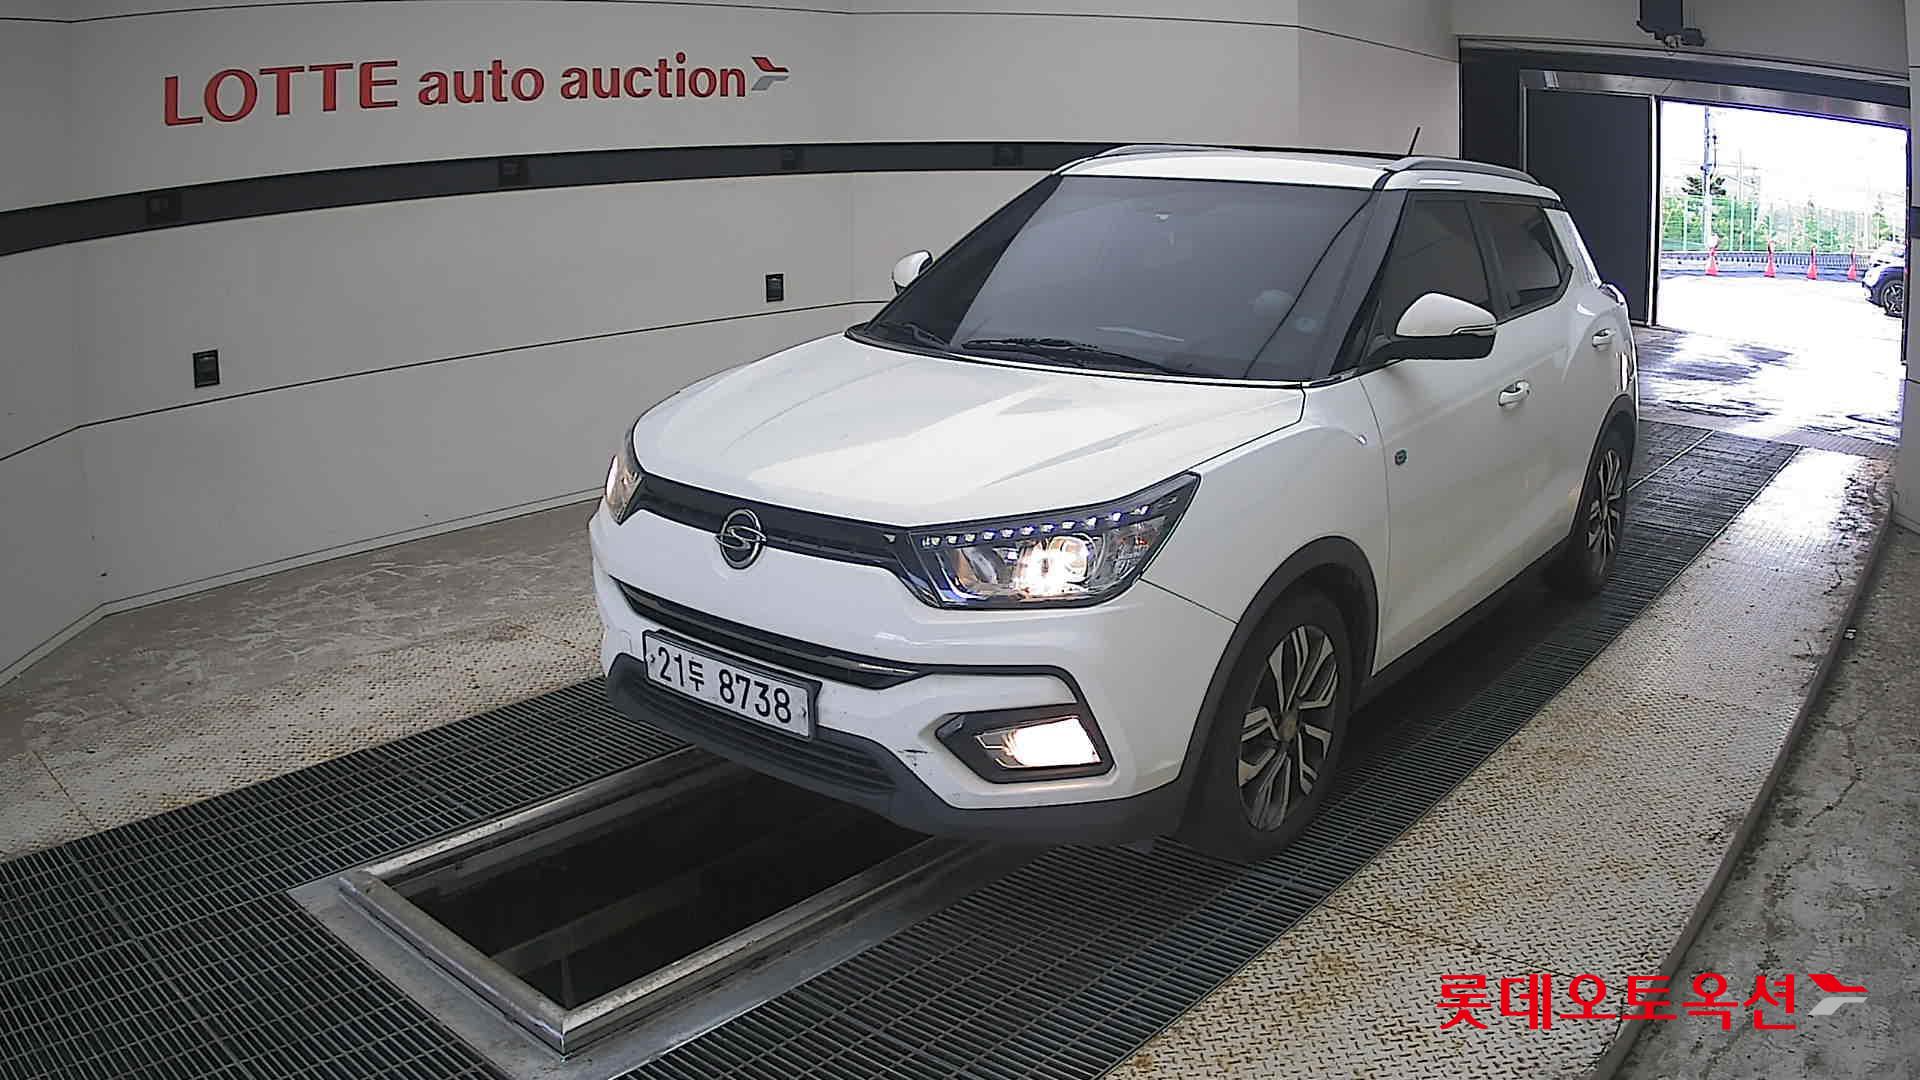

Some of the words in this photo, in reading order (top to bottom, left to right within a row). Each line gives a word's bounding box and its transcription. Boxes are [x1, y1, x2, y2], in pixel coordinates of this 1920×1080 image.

[164, 60, 398, 126] LOTTE
[418, 60, 545, 105] auto
[560, 52, 746, 99] auction
[658, 647, 705, 692] 21두
[718, 669, 792, 724] 8738
